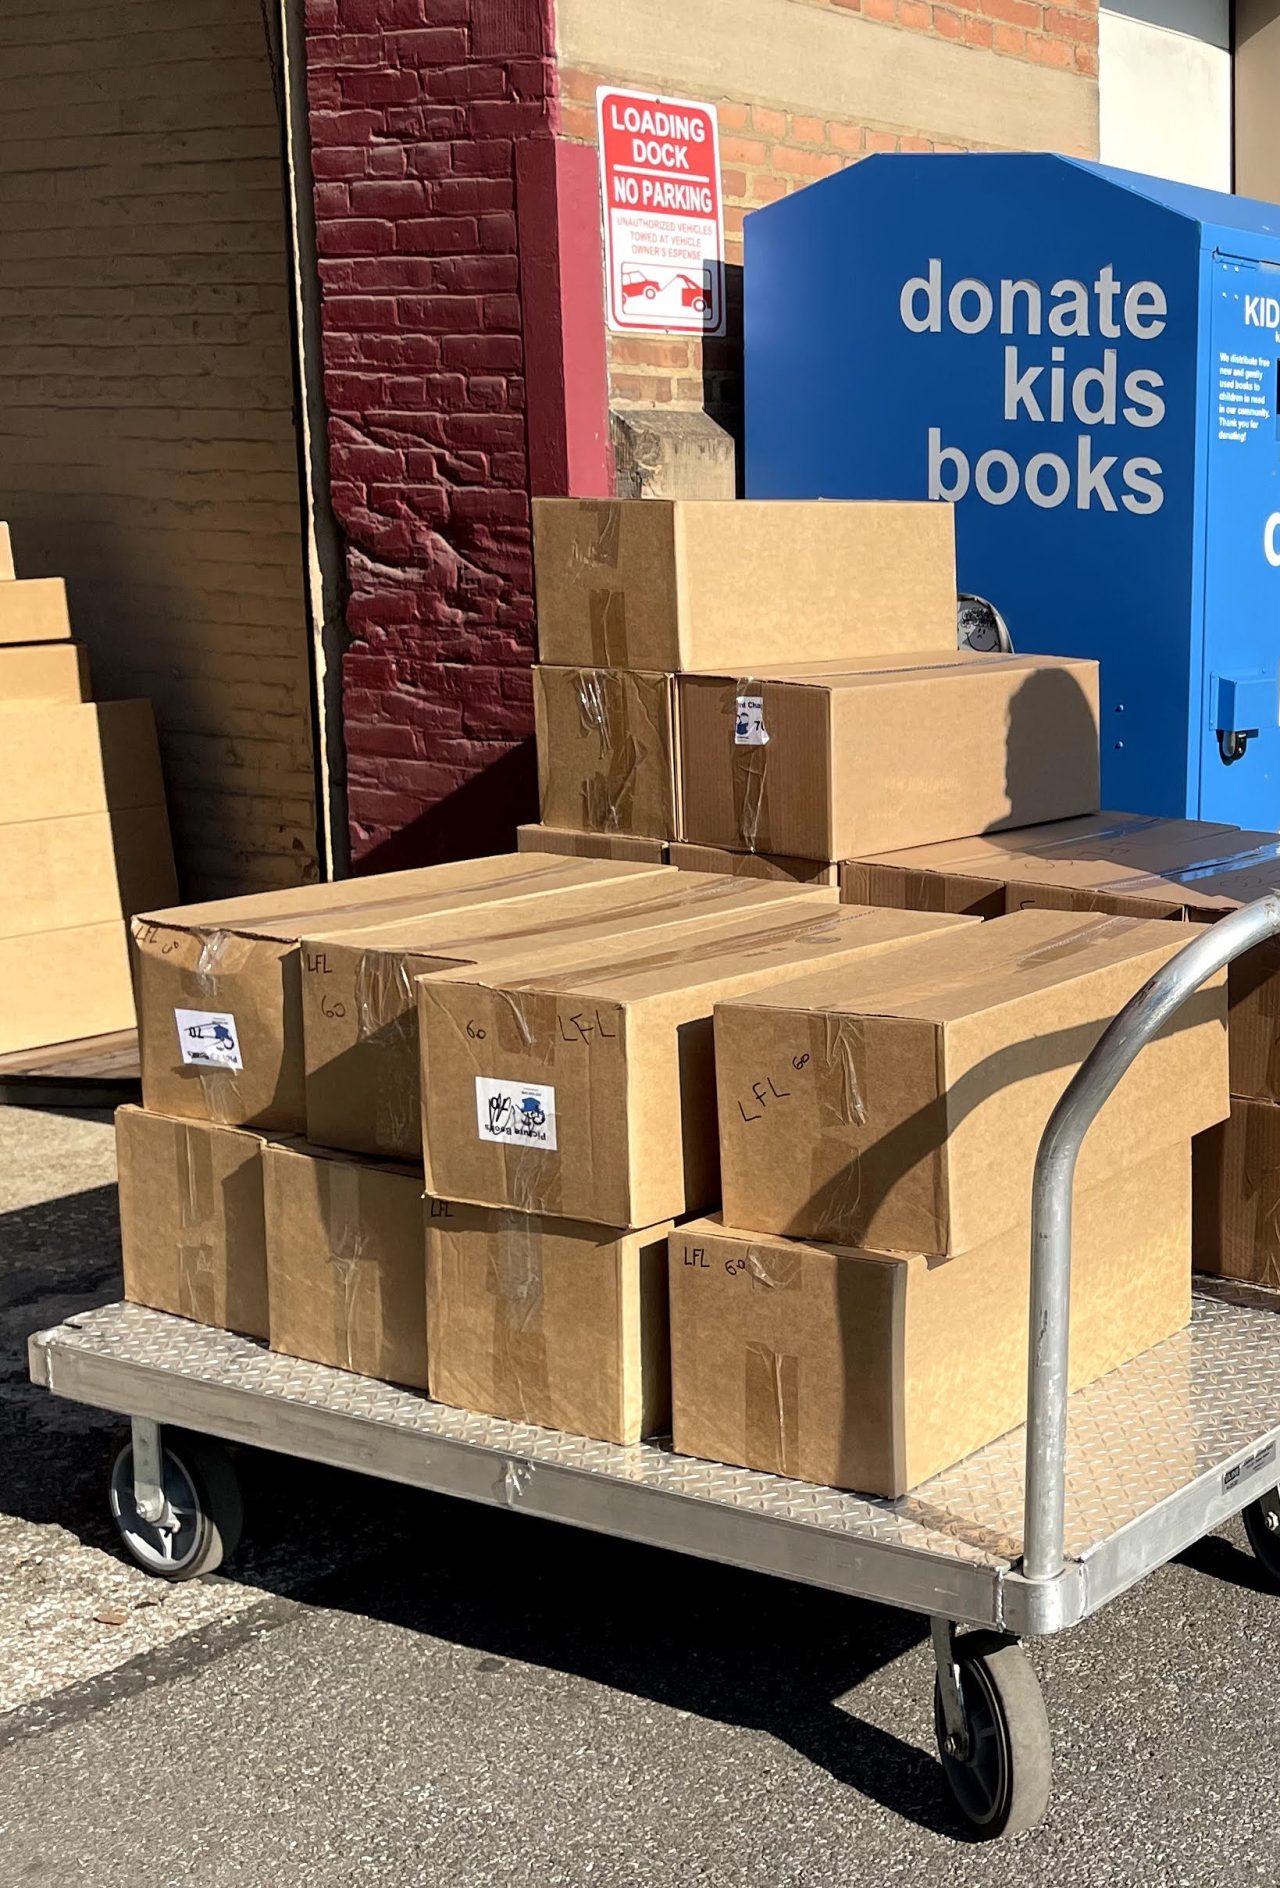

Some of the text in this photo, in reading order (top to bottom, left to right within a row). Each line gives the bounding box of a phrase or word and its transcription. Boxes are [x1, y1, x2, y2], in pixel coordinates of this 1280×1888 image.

[610, 104, 705, 143] LOADING
[632, 138, 690, 169] DOCK
[613, 176, 713, 213] NO PARKING
[617, 217, 712, 235] UNAUTHORIZED VEHICLES
[630, 231, 701, 248] TOWED AT VEHICLE
[632, 244, 666, 257] OWNER'S
[900, 258, 1167, 339] donate
[1004, 345, 1166, 427] kids
[928, 427, 1165, 515] books
[307, 953, 332, 974] LFL
[465, 1009, 616, 1045] 60 LFL
[737, 1077, 791, 1122] LFL
[684, 1246, 710, 1268] LFL
